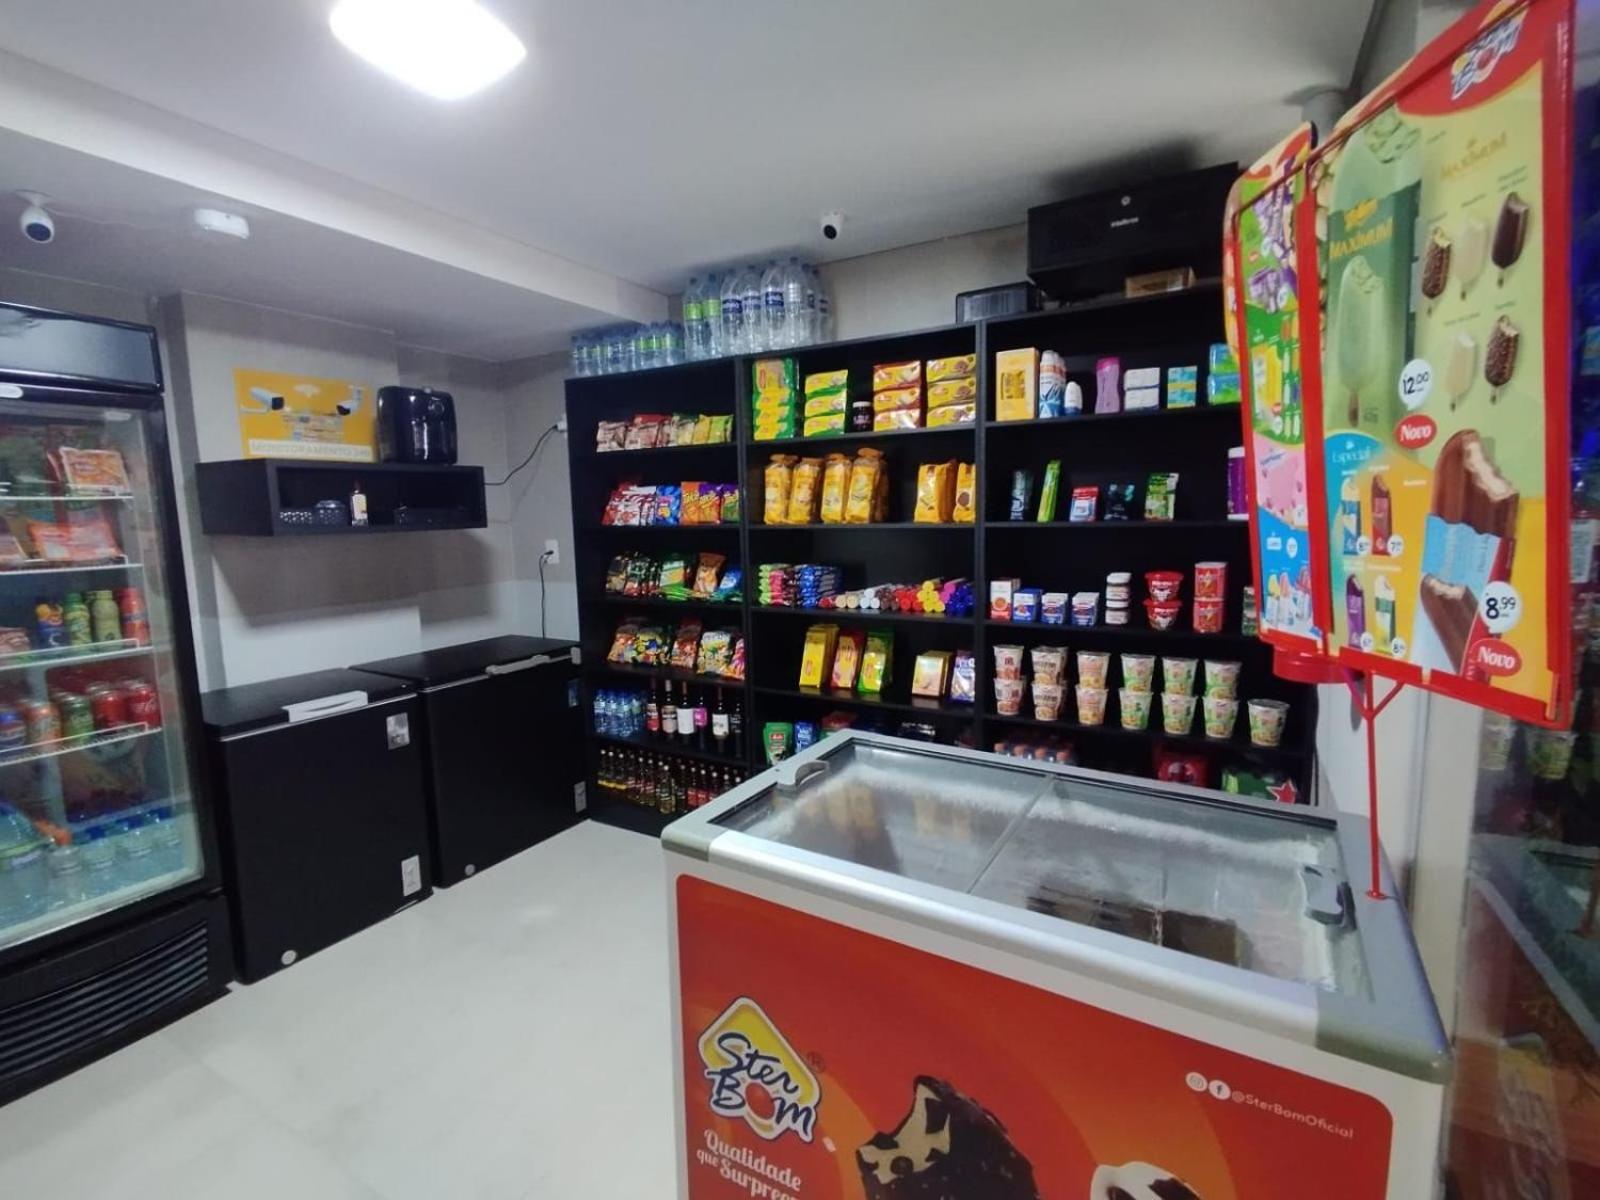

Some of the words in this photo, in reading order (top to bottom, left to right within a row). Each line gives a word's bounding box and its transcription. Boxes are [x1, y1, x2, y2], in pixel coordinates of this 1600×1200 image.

[1400, 424, 1433, 442] Novo
[1478, 645, 1516, 669] Novo
[717, 1032, 799, 1093] Ster
[1232, 1090, 1354, 1139] @SterBomOficial
[697, 1149, 719, 1168] que
[704, 1129, 802, 1191] Qualidade
